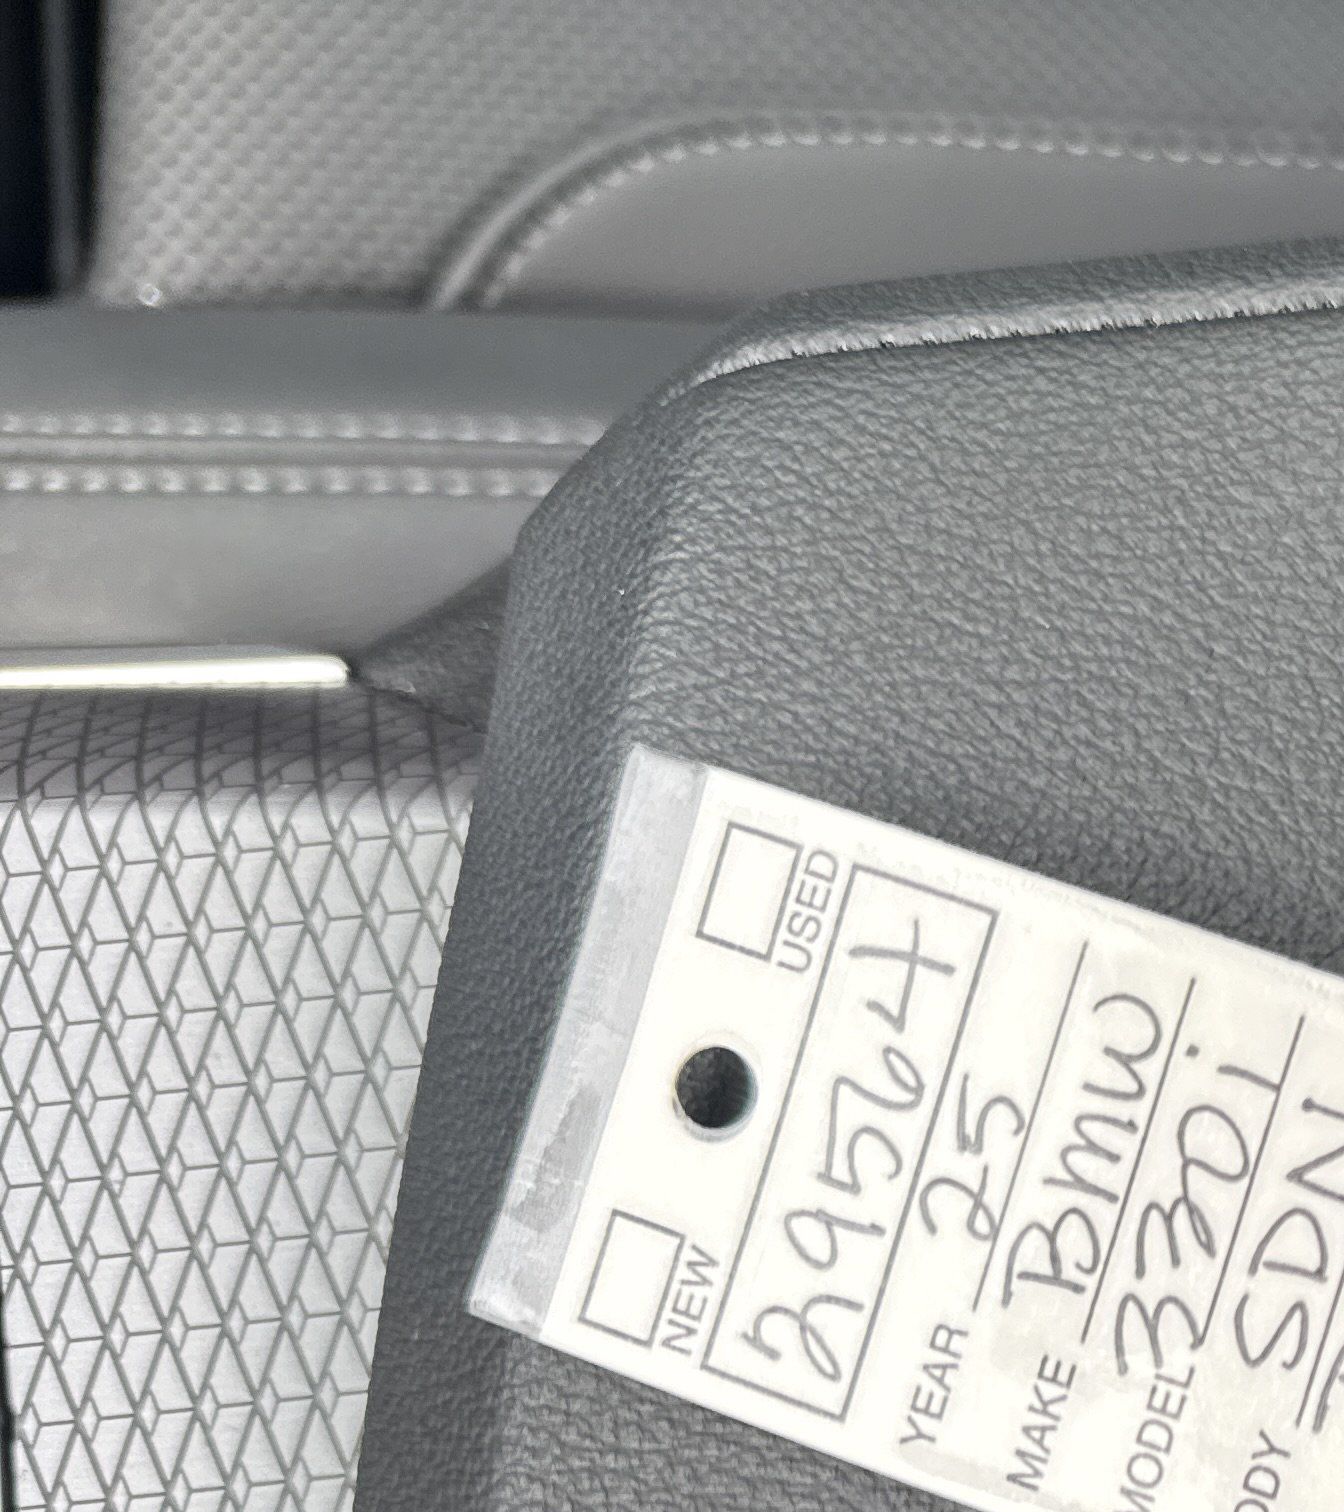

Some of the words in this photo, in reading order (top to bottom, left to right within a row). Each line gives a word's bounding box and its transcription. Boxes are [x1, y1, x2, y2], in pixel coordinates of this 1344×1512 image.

[777, 849, 839, 975] USED
[740, 918, 956, 1382] 29564
[920, 1073, 1027, 1241] 25
[1113, 1044, 1282, 1377] 330i
[662, 1246, 720, 1357] NEW
[899, 1322, 970, 1449] YEAR
[1006, 1354, 1077, 1494] MAKE
